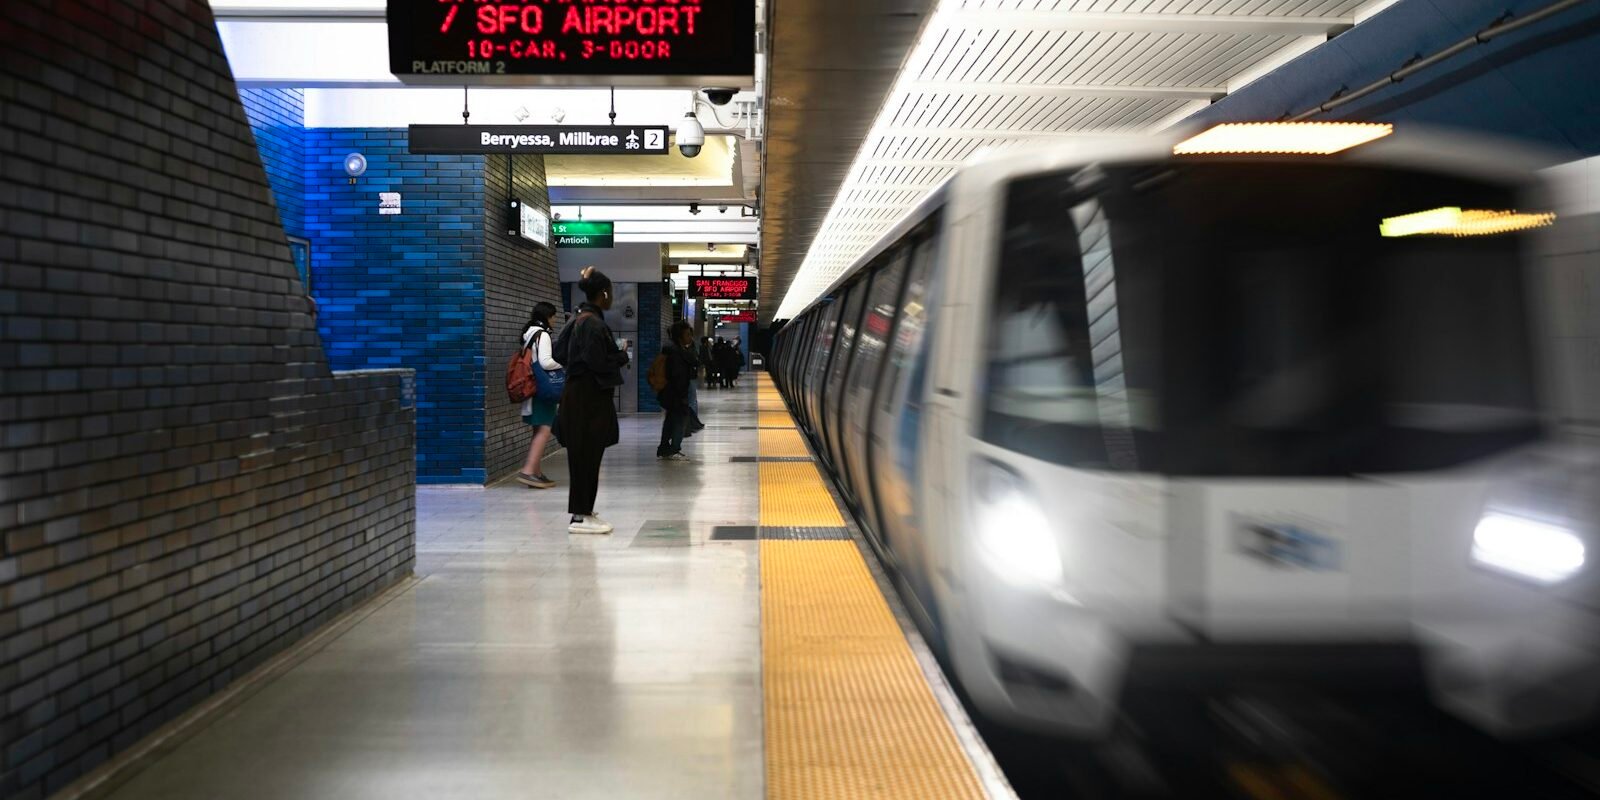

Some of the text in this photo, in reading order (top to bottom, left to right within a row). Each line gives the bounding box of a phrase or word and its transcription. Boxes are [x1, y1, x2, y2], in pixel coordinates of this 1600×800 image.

[476, 4, 543, 34] SFO
[562, 4, 701, 34] AIRPORT
[467, 40, 671, 60] 10-CAR, 3-DOOR
[412, 60, 506, 73] PLATFORM 2
[480, 132, 659, 150] Berryessa, Millbrae SFO 2
[558, 225, 567, 233] St
[559, 236, 590, 244] Antioch
